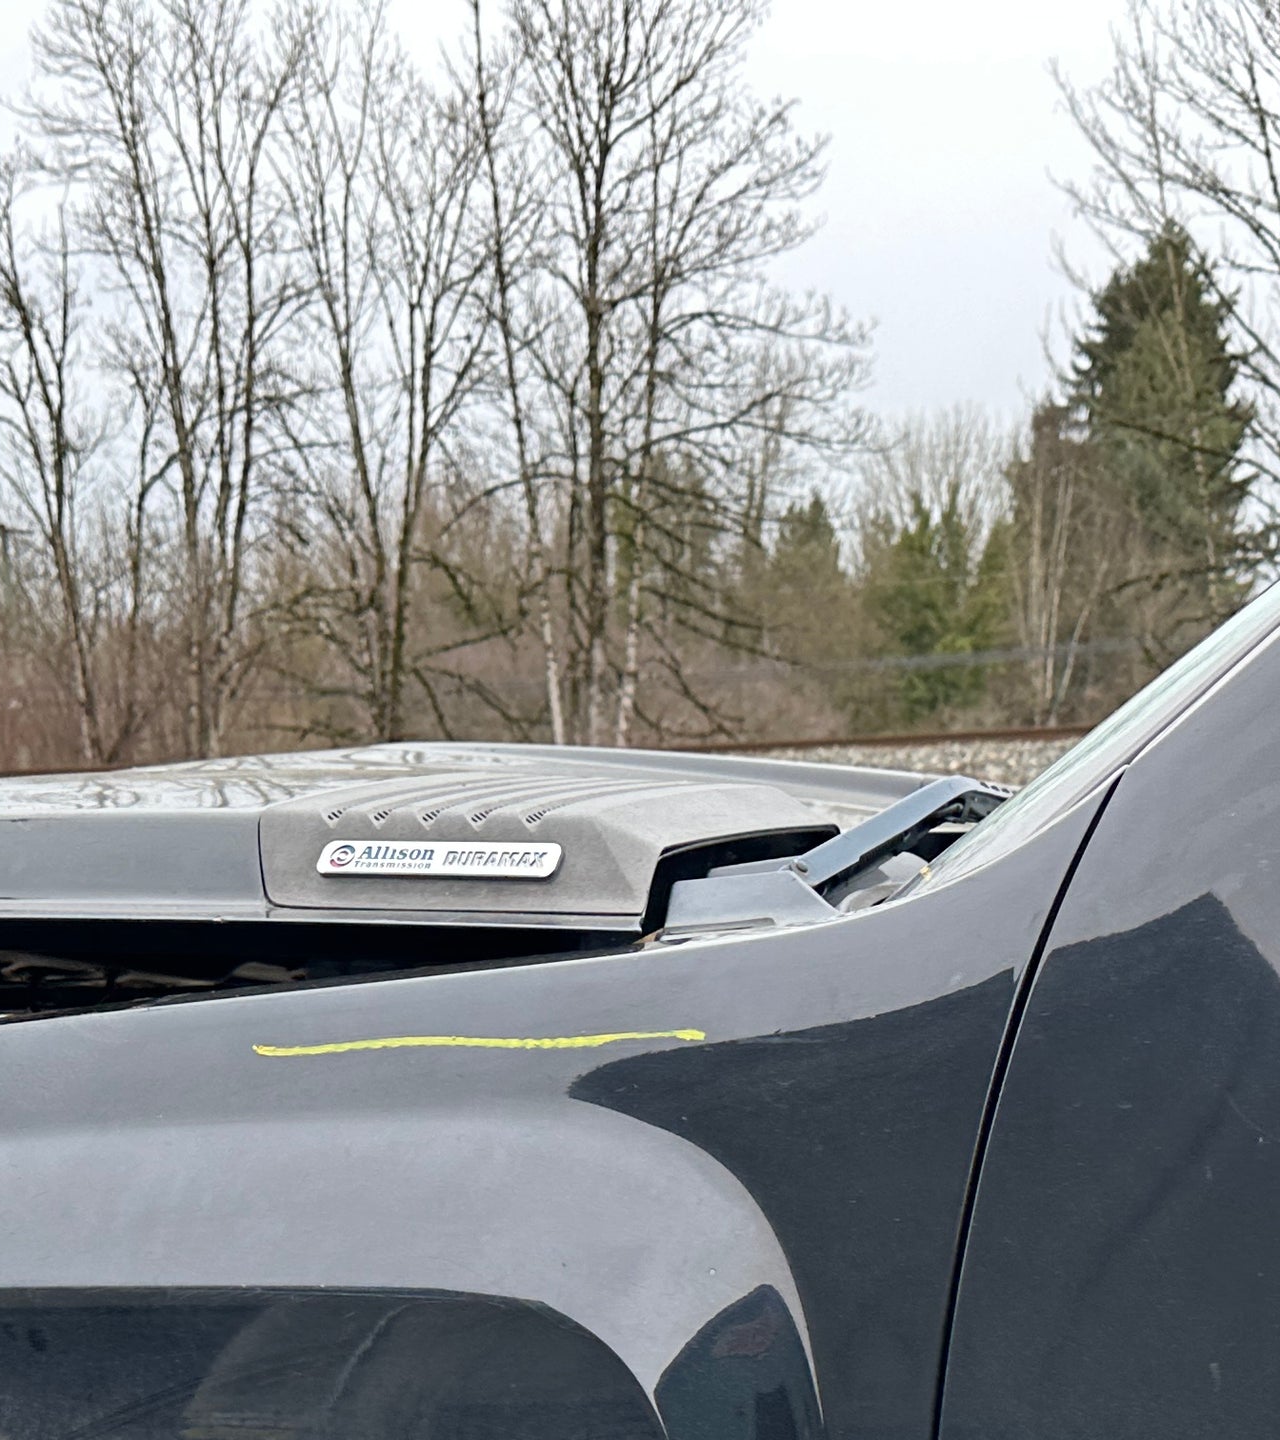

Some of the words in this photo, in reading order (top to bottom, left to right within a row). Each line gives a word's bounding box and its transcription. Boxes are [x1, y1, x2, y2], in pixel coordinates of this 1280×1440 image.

[356, 845, 435, 861] Allison
[440, 850, 547, 868] DURAMAX
[353, 859, 432, 870] Transmission
